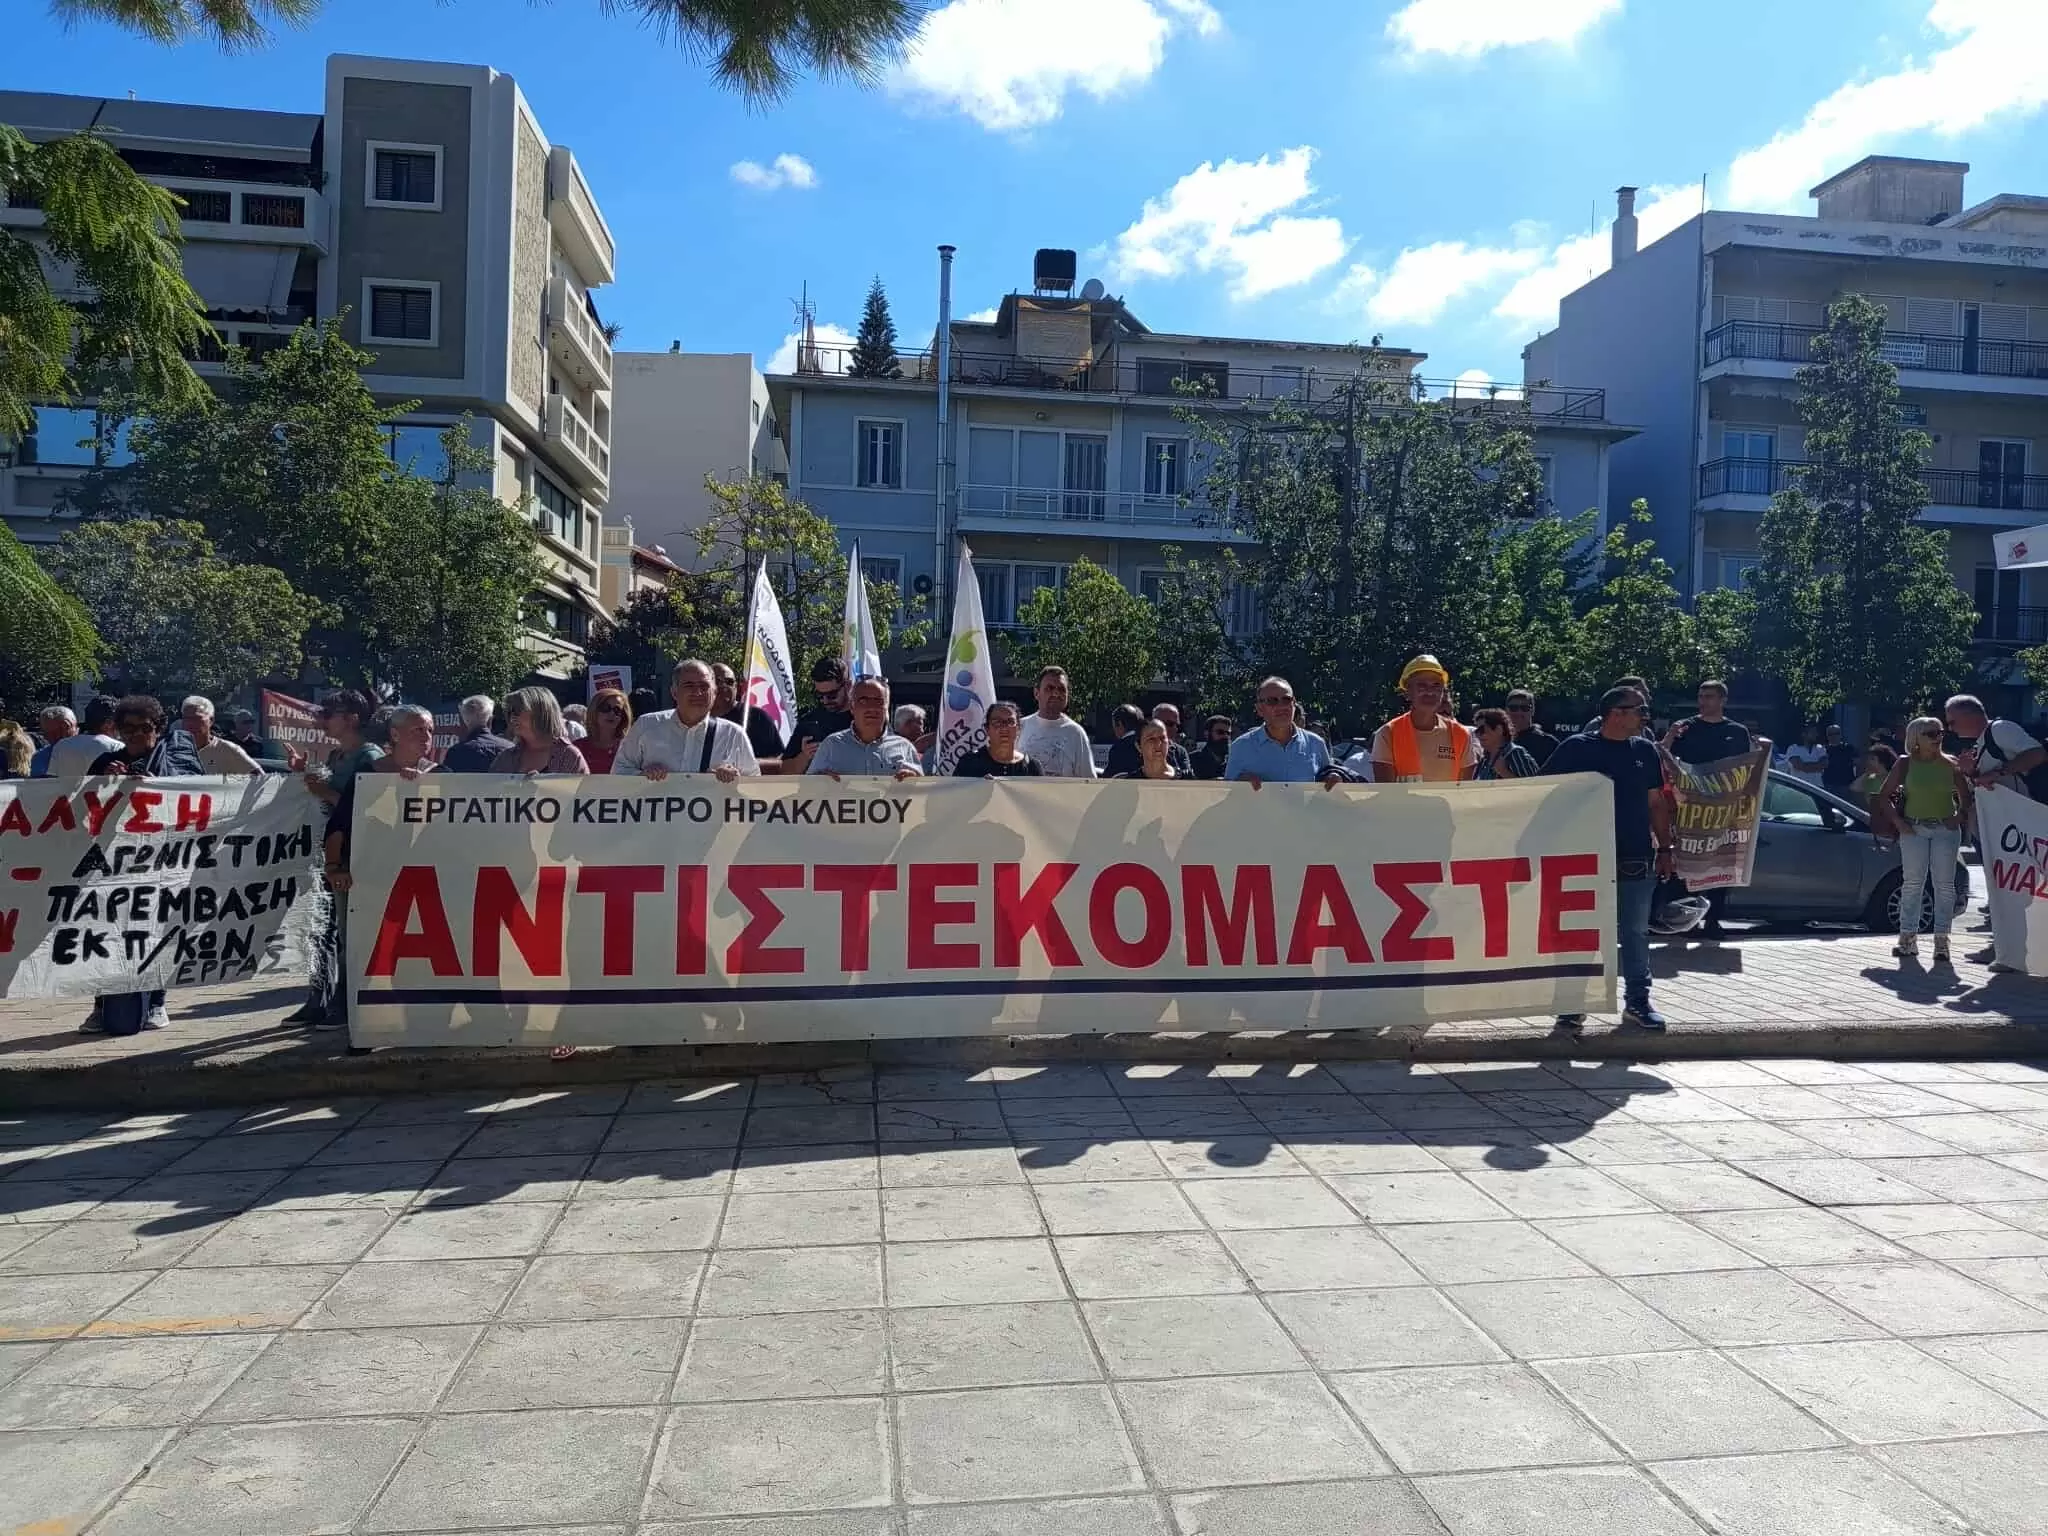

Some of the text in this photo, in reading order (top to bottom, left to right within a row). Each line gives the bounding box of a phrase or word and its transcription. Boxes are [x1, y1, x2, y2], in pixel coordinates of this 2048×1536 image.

[403, 796, 912, 824] ΕΡΓΑΤΙΚΟ ΚΕΝΤΡΟ ΗΡΑΚΛΕΙΟΥ
[72, 824, 312, 878] ΑΓΩΝΙΣΤΙΚΗ
[47, 877, 297, 924] ΠΑΡΕΜΒΑΣΗ
[365, 855, 1599, 976] ΑΝΤΙΣΤΕΚΟΜΑΣΤΕ
